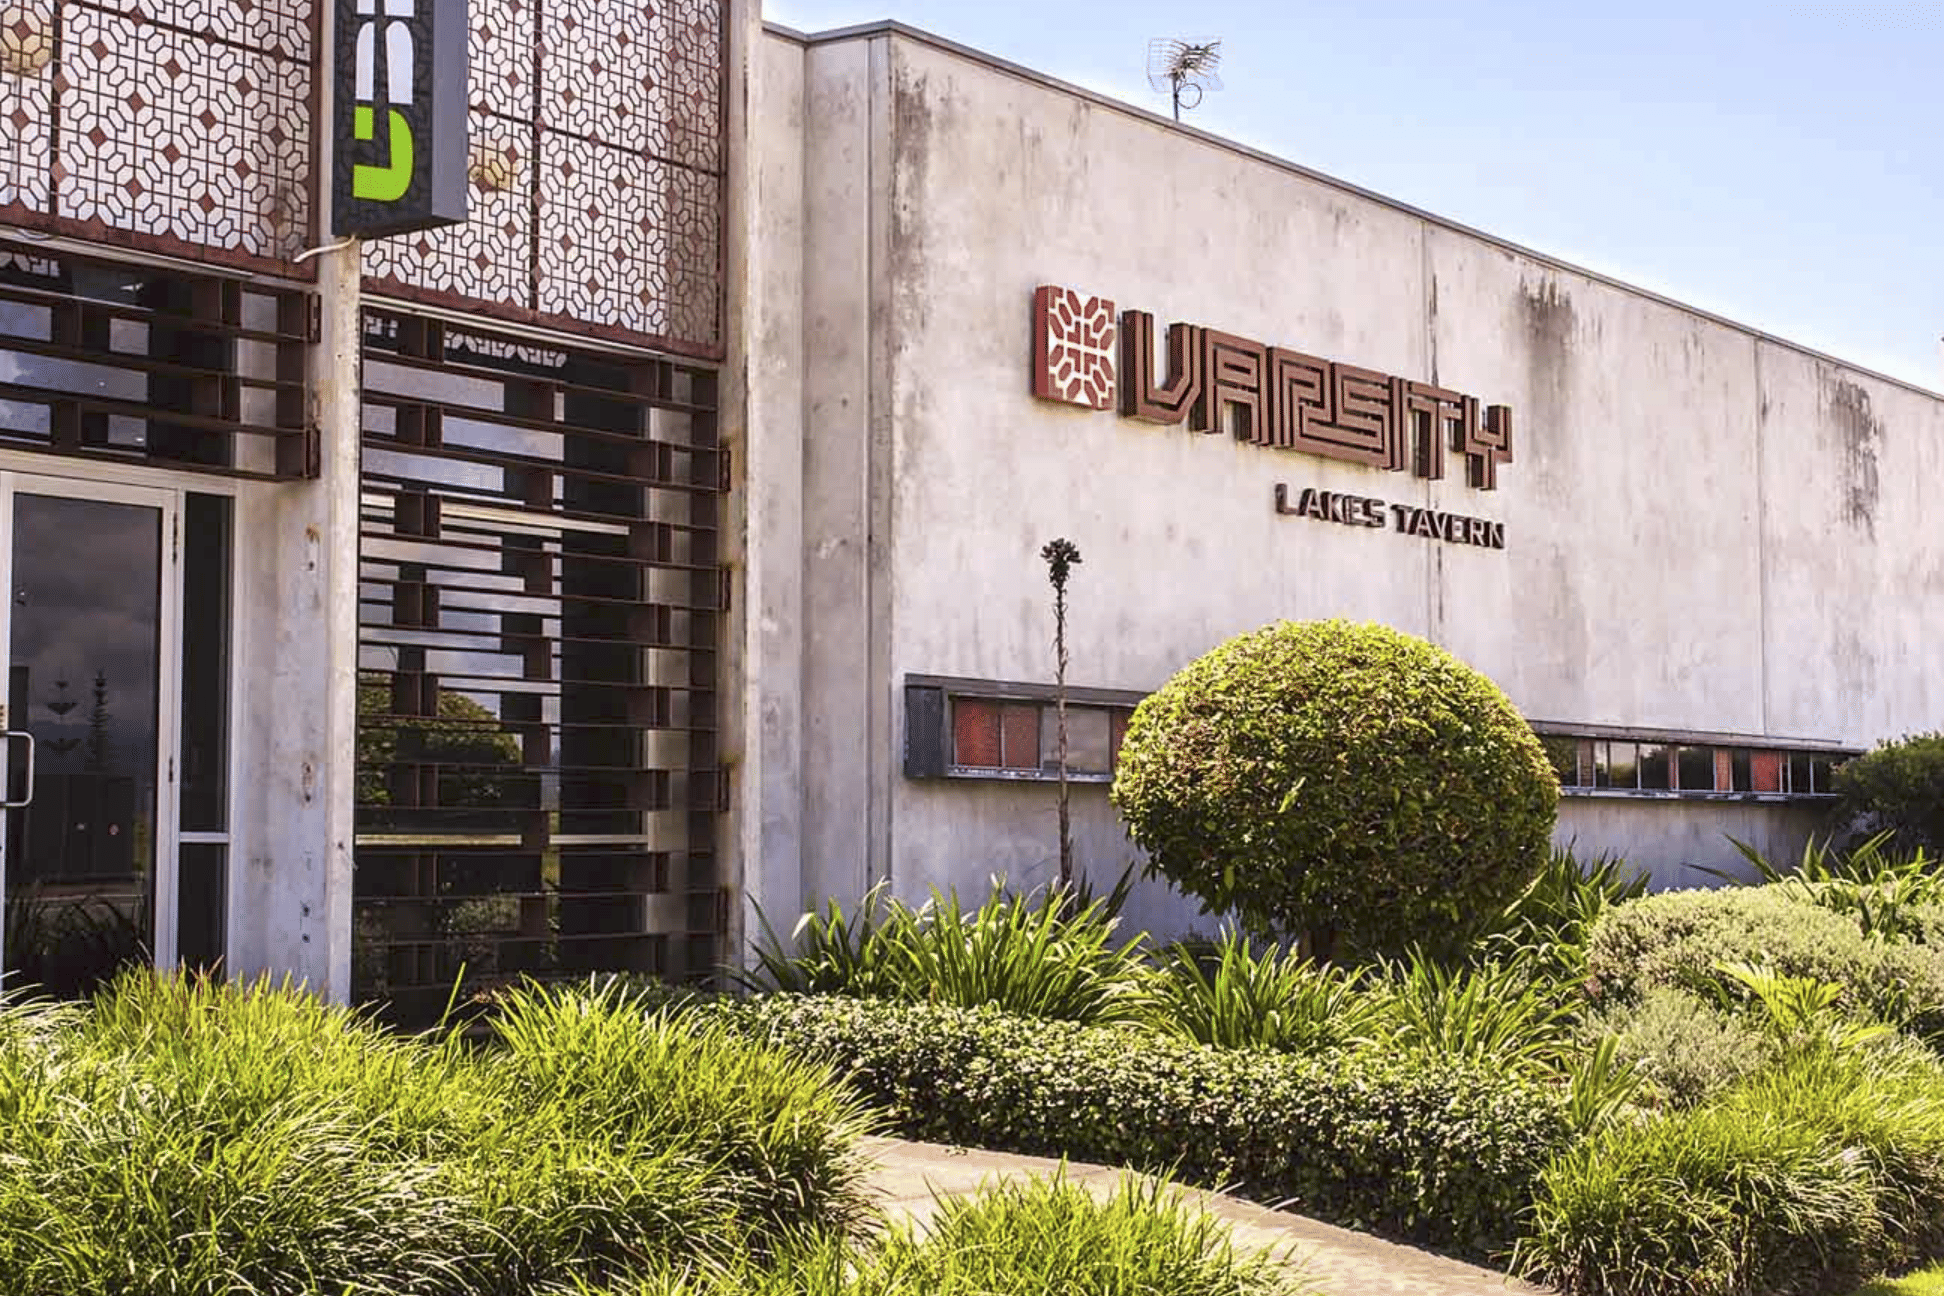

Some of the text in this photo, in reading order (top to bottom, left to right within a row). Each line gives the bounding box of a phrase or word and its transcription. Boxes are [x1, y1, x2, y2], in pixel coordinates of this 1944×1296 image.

[1122, 309, 1513, 491] VARSITY
[1275, 483, 1505, 550] LAKES TAVERN
